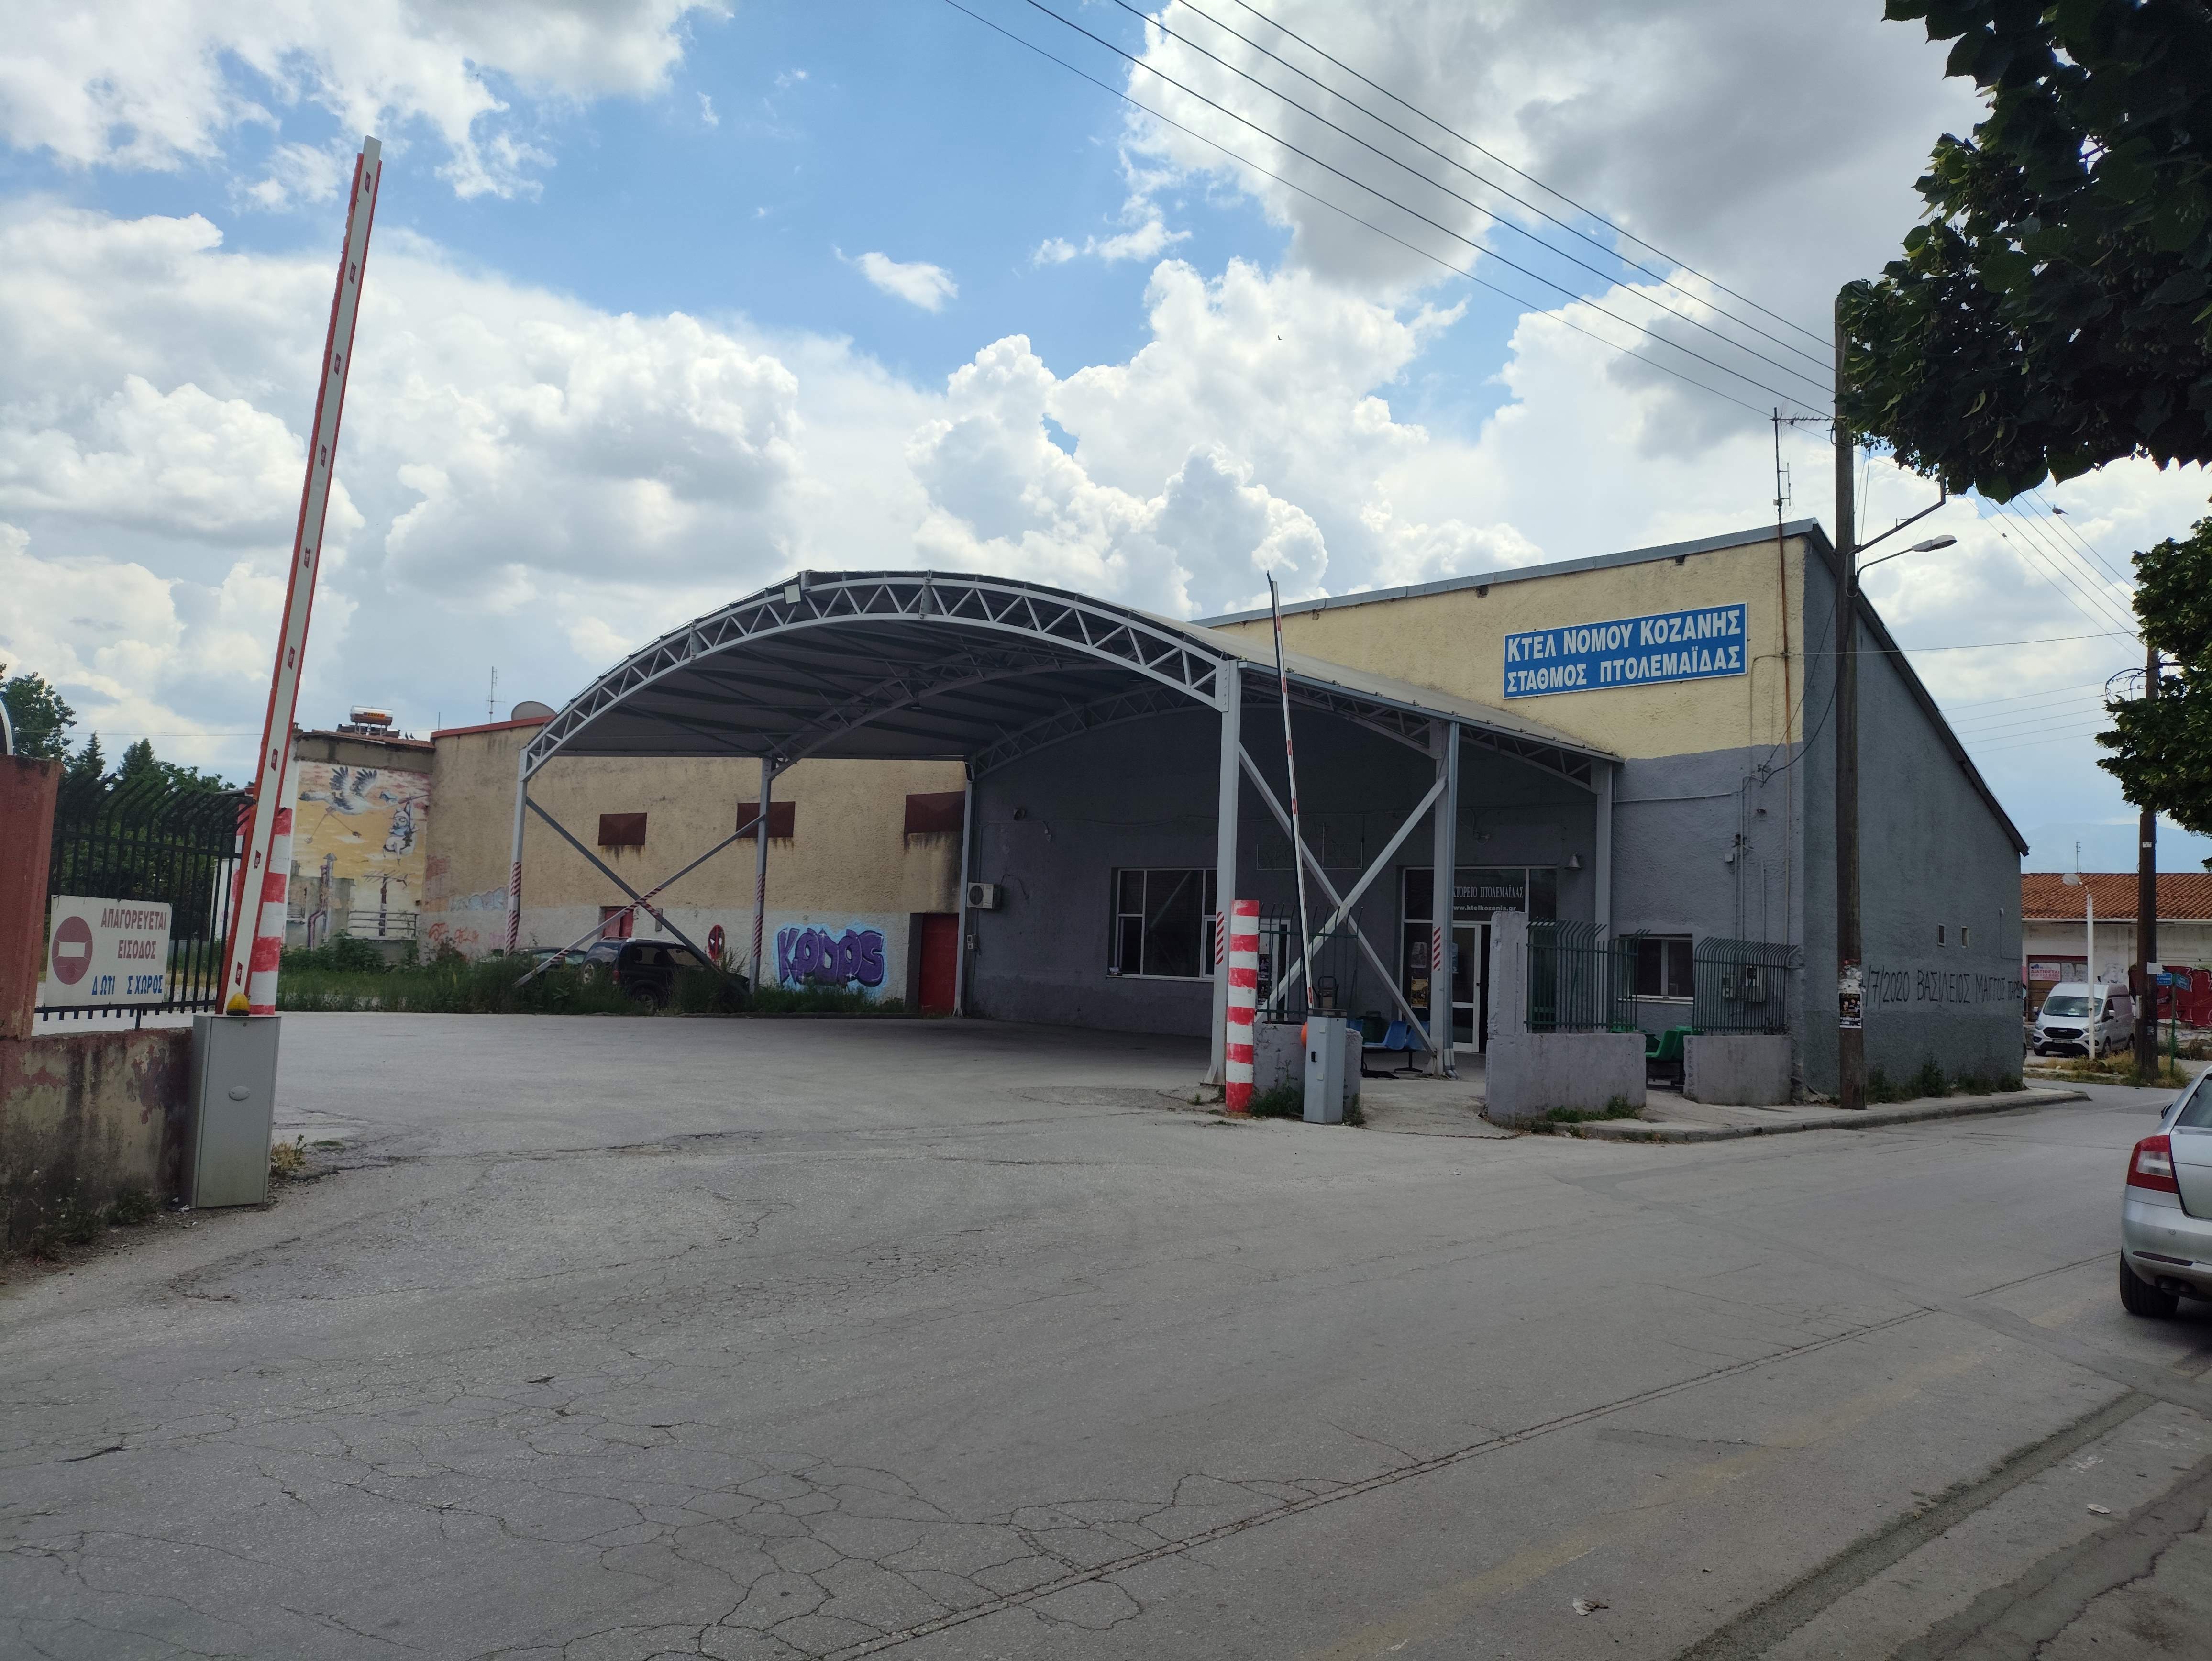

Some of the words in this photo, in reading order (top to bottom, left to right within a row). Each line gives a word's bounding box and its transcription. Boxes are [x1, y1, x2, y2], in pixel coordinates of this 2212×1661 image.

[1507, 634, 1557, 663] ΚΤΕΛ
[1563, 623, 1633, 655] ΝΟΜΟΥ
[1640, 609, 1741, 646] ΚΟΖΑΝΗΣ
[1507, 664, 1587, 693] ΣΤΑΘΜΟΣ
[1600, 645, 1740, 683] ΠΤΟΛΕΜΑΪΔΑΣ
[1480, 885, 1524, 898] ΠΤΟΛΕΜΑΪΔΑΣ
[100, 908, 167, 930] ΑΠΑΓΟΡΕΥΕΤΑΙ
[118, 940, 156, 959] ΕΙΣΟΔΟΣ
[1917, 970, 1971, 1003] ΒΑΣΙΛΕΙΟΣ
